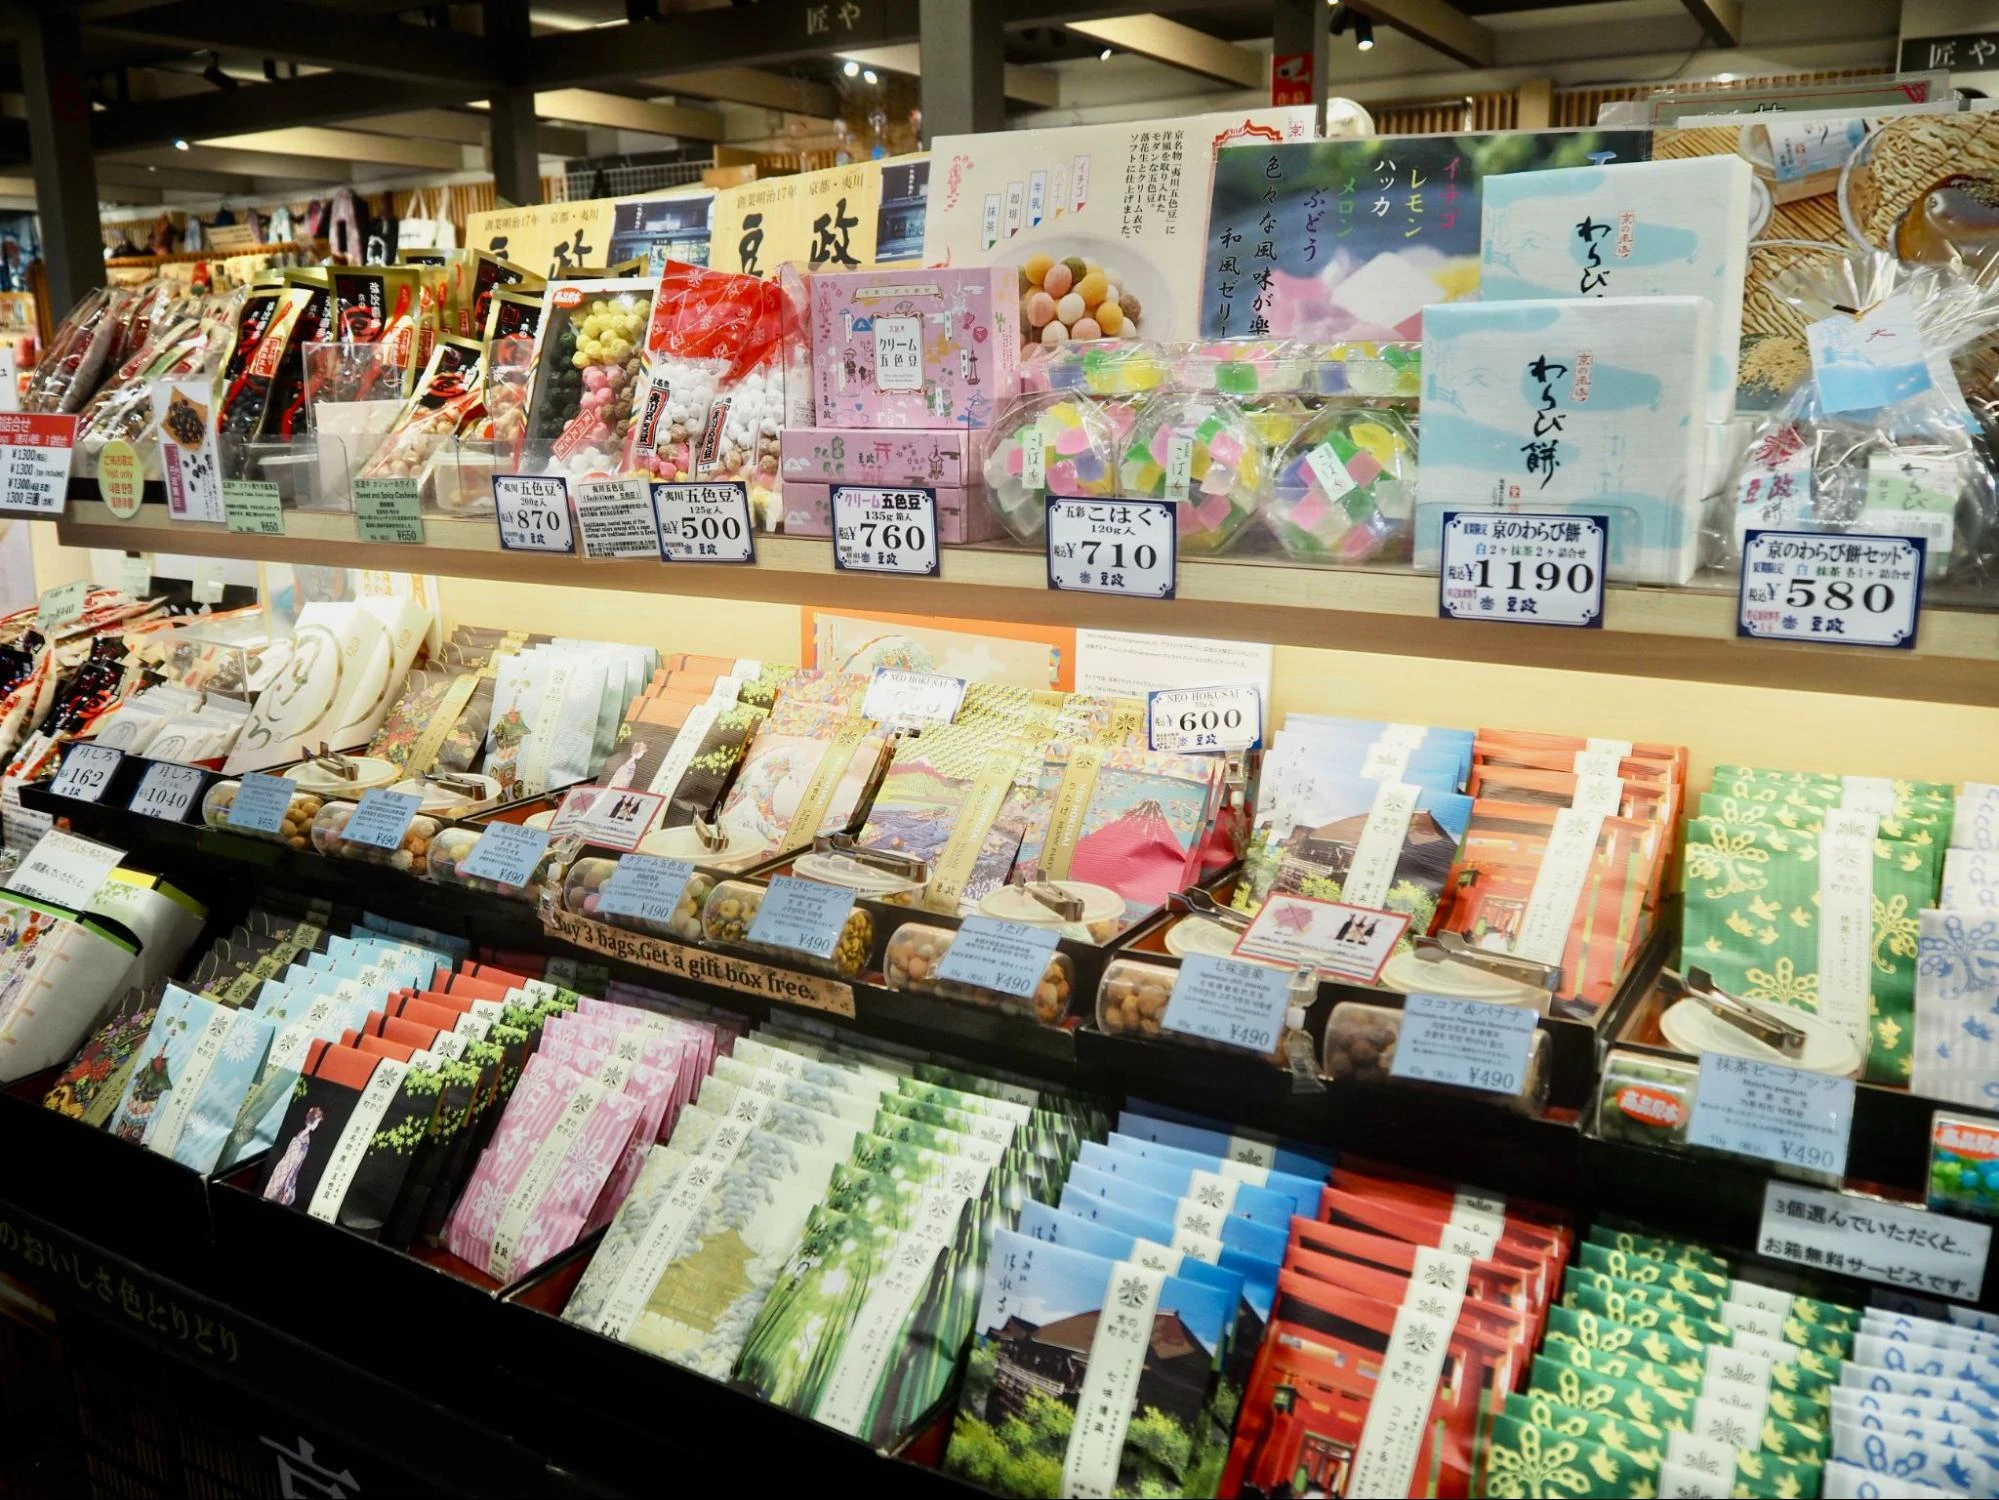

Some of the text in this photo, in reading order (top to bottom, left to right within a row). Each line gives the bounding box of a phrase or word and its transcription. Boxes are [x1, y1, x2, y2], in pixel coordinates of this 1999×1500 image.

[808, 3, 861, 34] 匠や
[1929, 38, 1996, 69] 匠や
[1076, 161, 1087, 199] イチゴ
[1146, 132, 1161, 208] モダンな五色豆。
[1156, 131, 1173, 213] 洋風を取り入れた
[736, 174, 863, 209] 創業明治17年 京都・夷川
[1121, 134, 1140, 239] ソフトに仕上げました。
[1132, 133, 1150, 234] 落花生とクリーム衣で
[1166, 130, 1184, 234] 京名物「夷川五色豆」に
[1371, 160, 1396, 217] ハッカ
[1440, 156, 1461, 230] イチゴ
[1008, 192, 1020, 220] 珈琲
[1031, 182, 1042, 209] 牛乳
[1405, 169, 1428, 238] レモン
[986, 206, 998, 233] 抹茶
[1338, 178, 1357, 239] メロン
[1303, 187, 1327, 262] ぶどう
[1576, 216, 1612, 296] わらび
[1218, 228, 1242, 337] 和風ゼリー
[879, 338, 918, 352] クリーム
[879, 353, 918, 368] 五色豆
[1521, 355, 1568, 490] わらび餅
[12, 449, 35, 462] ¥1300
[10, 464, 33, 475] ¥1300
[8, 479, 31, 490] ¥1300
[520, 481, 557, 497] 五色豆
[664, 488, 734, 504] 夷川 五色豆
[689, 506, 723, 517] 125g入
[844, 492, 922, 511] クリーム五色豆
[1088, 506, 1153, 527] こはく
[396, 530, 417, 541] ¥650
[1091, 524, 1136, 536] 120g入
[1492, 520, 1581, 543] 京のわらび餅
[877, 552, 898, 566] 豆政
[1768, 540, 1902, 566] 京のわらび餅セット
[1100, 571, 1126, 587] 豆政
[1816, 565, 1841, 577] 抹茶
[1506, 596, 1538, 615] 豆政
[1811, 616, 1845, 634] 豆政
[1167, 688, 1240, 704] NEO HOKUSAI
[1196, 732, 1217, 746] 豆政
[80, 747, 113, 762] 月しろ
[159, 765, 193, 783] 月しろ
[1063, 800, 1080, 849] HOKUSAI
[375, 832, 397, 847] ¥490
[499, 867, 525, 884] ¥490
[626, 855, 688, 873] クリーム五色豆
[774, 877, 854, 900] わさびピーナッツ
[640, 901, 669, 919] ¥490
[996, 921, 1027, 938] うたげ
[798, 932, 831, 952] ¥490
[584, 925, 594, 943] 3
[673, 953, 684, 969] a
[688, 954, 721, 980] gift
[726, 961, 762, 988] box
[768, 970, 816, 1001] free.
[995, 972, 1031, 992] ¥490
[1421, 998, 1523, 1022] ココア&バナナ
[1230, 1024, 1270, 1047] ¥490
[1469, 1067, 1515, 1091] ¥490
[1715, 1056, 1839, 1092] 抹茶ピーナッツ
[1780, 1140, 1835, 1169] ¥490
[1765, 1237, 1976, 1298] お箱無料サービスです。
